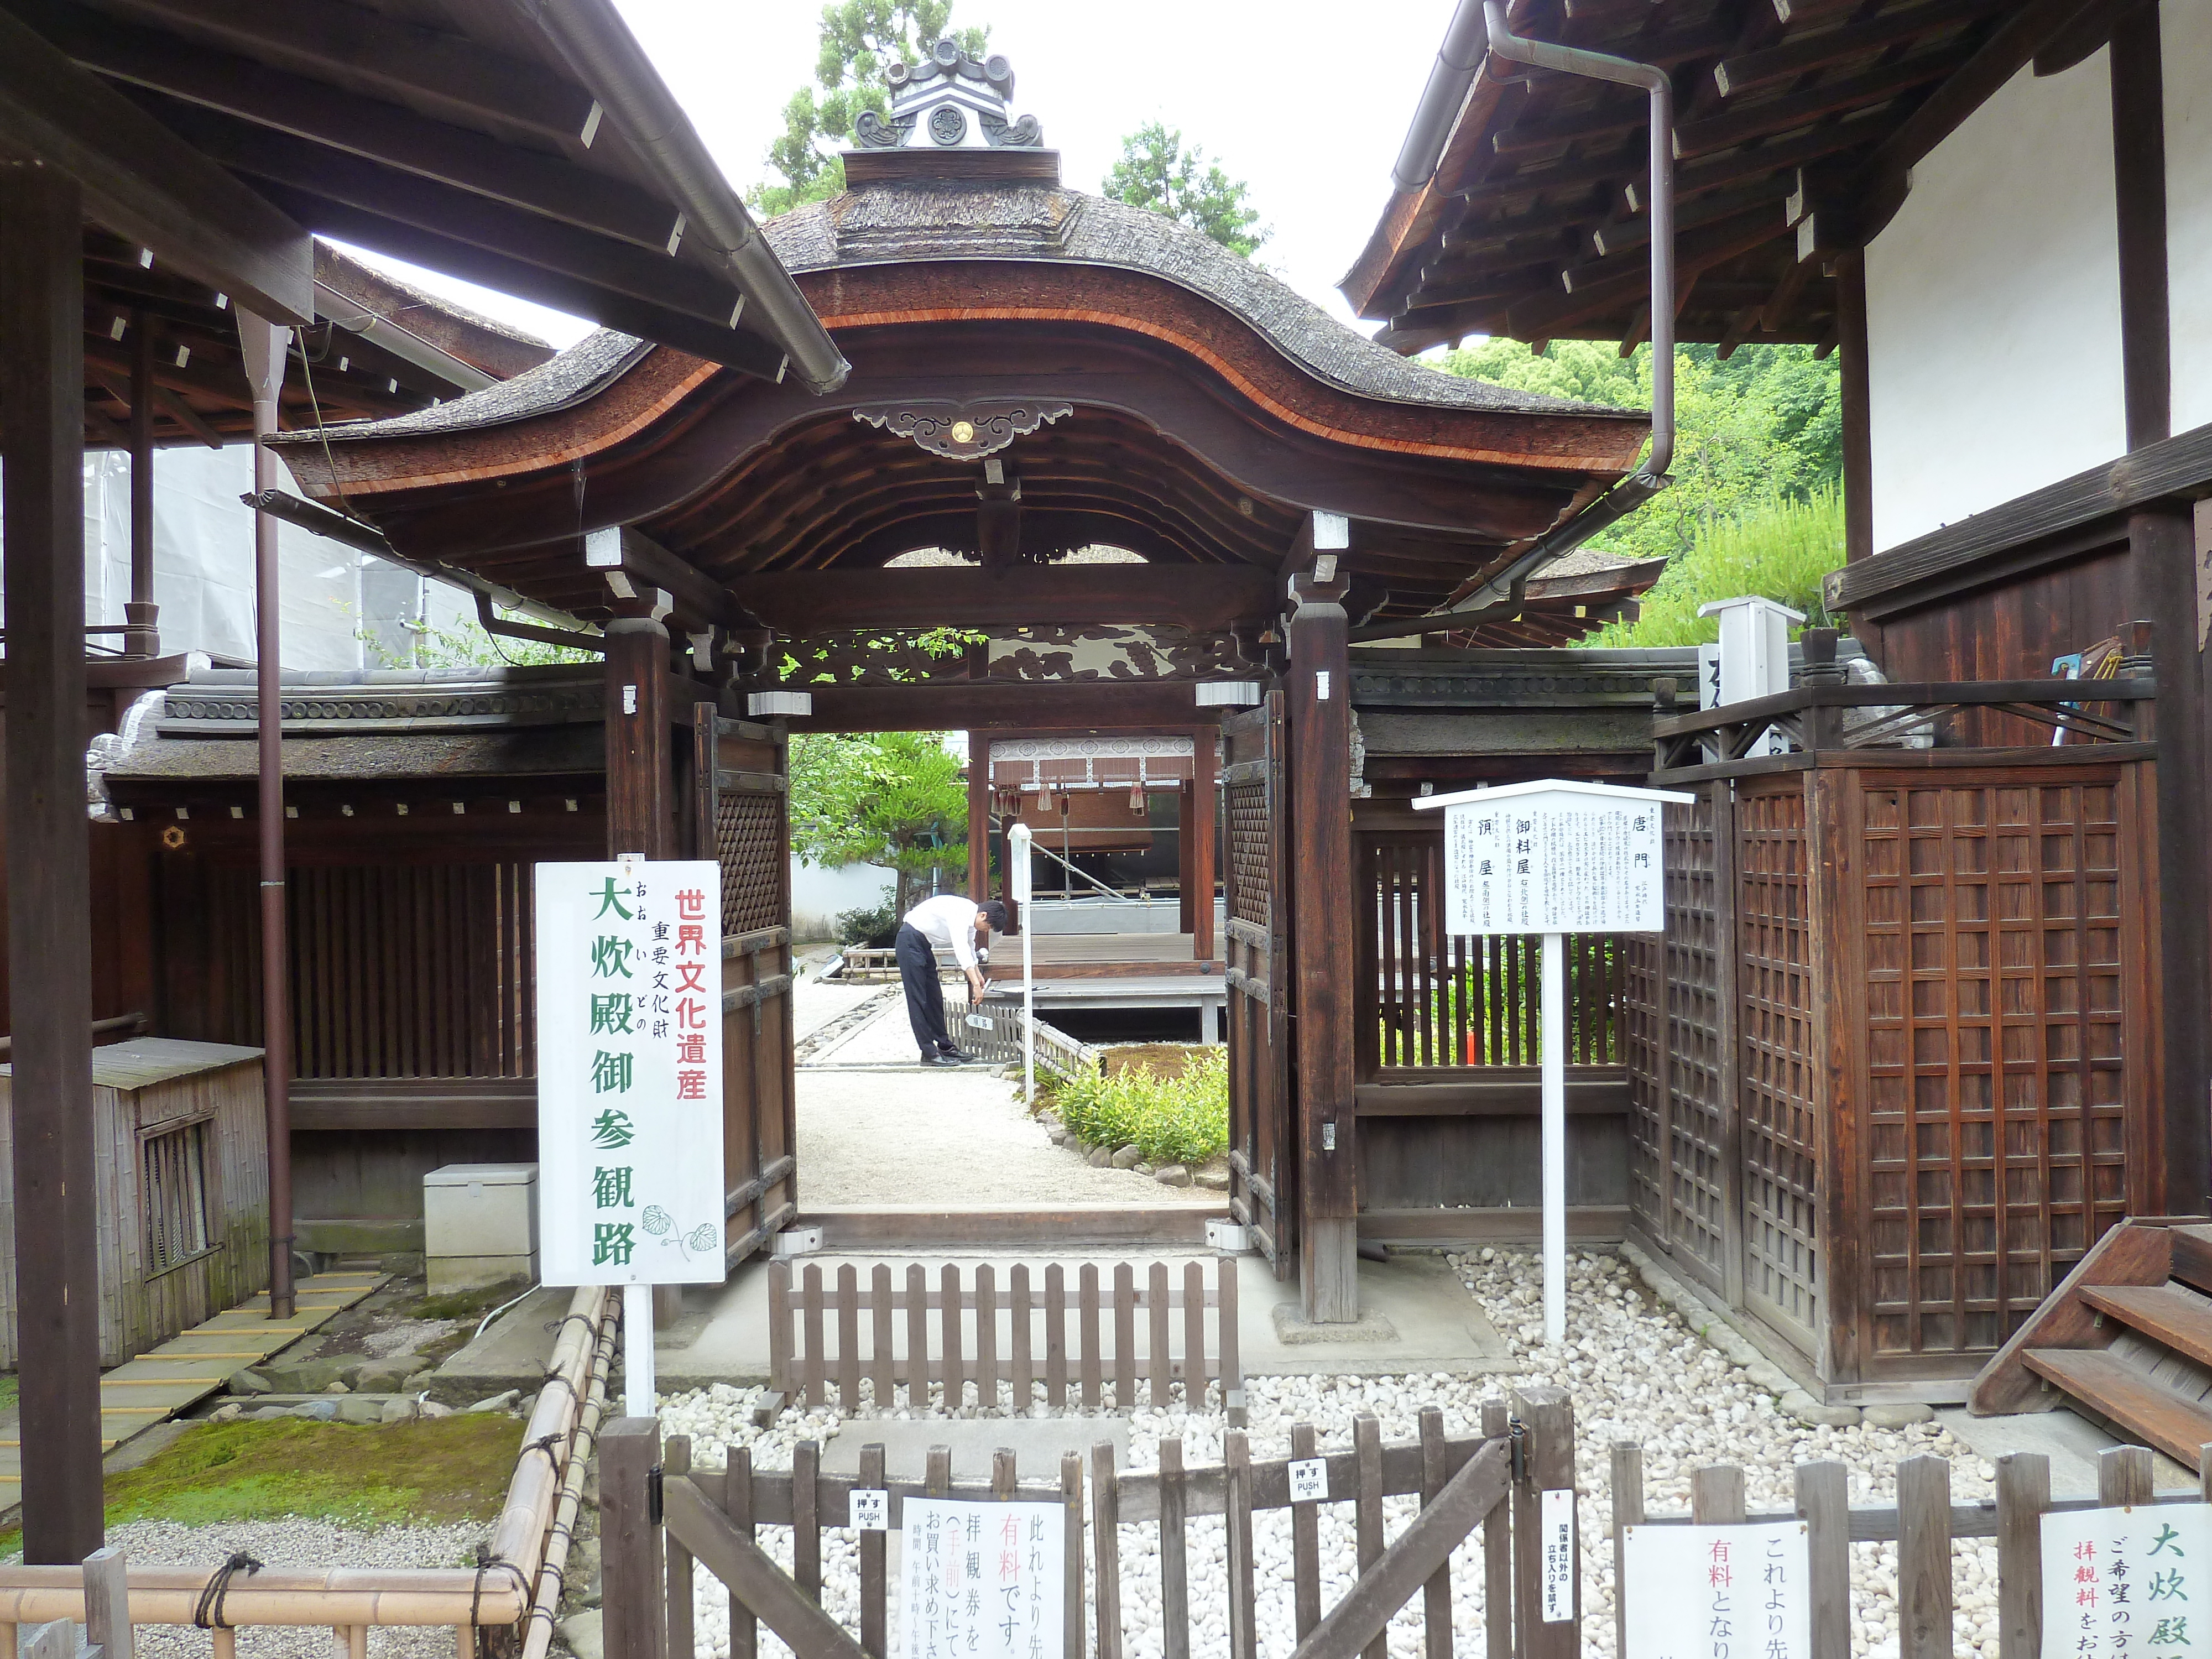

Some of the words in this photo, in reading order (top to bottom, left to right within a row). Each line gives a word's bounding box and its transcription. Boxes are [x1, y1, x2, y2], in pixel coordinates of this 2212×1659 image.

[1478, 820, 1493, 876] 預屋
[1516, 819, 1531, 875] 御料屋
[1631, 815, 1648, 869] 唐門
[636, 881, 648, 1030] おおいどの
[651, 921, 670, 1039] 重要文化財
[675, 889, 707, 1100] 世界文化遺産
[588, 877, 636, 1266] 大炊殿御参観路
[858, 1499, 880, 1509] 押す
[858, 1512, 880, 1521] PUSH
[1296, 1467, 1319, 1479] 押す
[1297, 1480, 1319, 1491] PUSH
[912, 1524, 921, 1551] 時間
[925, 1511, 940, 1659] お買い求め下さ
[966, 1513, 980, 1651] 拝観券を
[999, 1514, 1021, 1654] 有料です。
[1029, 1514, 1044, 1659] 此れより先
[1559, 1524, 1568, 1581] 関係者以外の
[2146, 1522, 2191, 1659] 大炊殿
[1708, 1539, 1733, 1659] 有料となり
[1764, 1538, 1787, 1659] これより先
